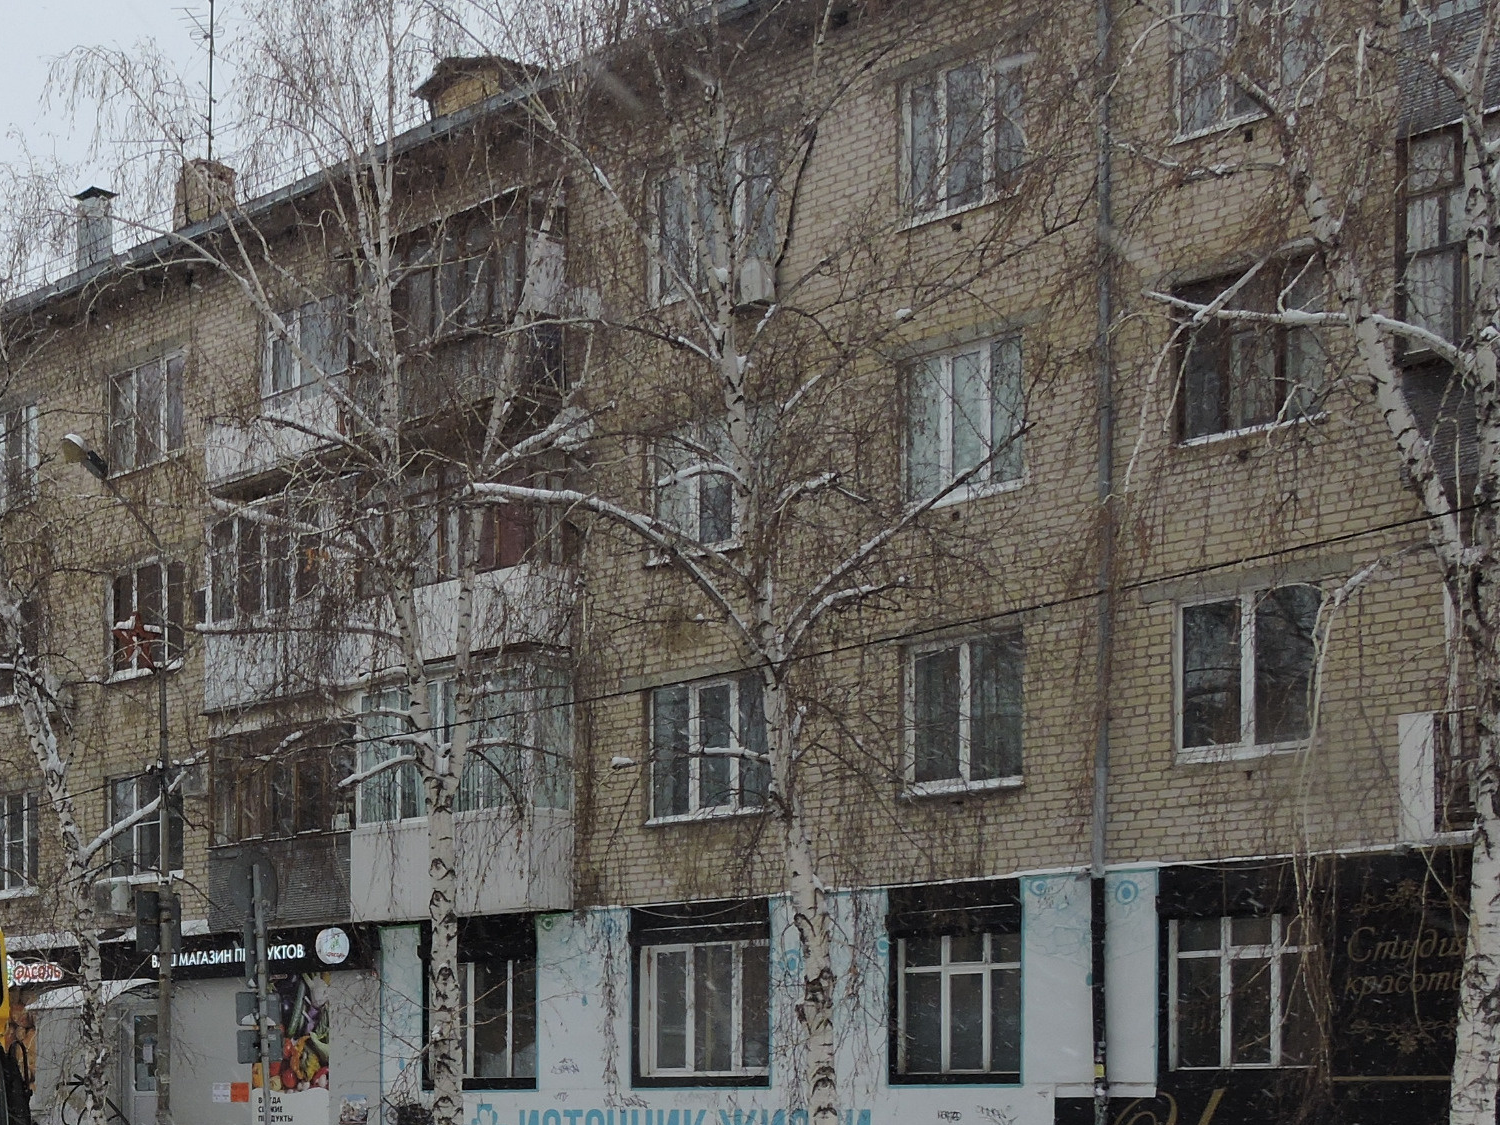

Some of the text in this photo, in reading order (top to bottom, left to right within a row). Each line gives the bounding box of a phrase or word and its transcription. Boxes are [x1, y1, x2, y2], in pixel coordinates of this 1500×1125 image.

[178, 947, 232, 967] МАГАЗИН
[234, 943, 306, 963] ПУКТОВ
[13, 964, 62, 981] ФАСОЛЬ
[258, 1105, 283, 1113] СЖИЕ
